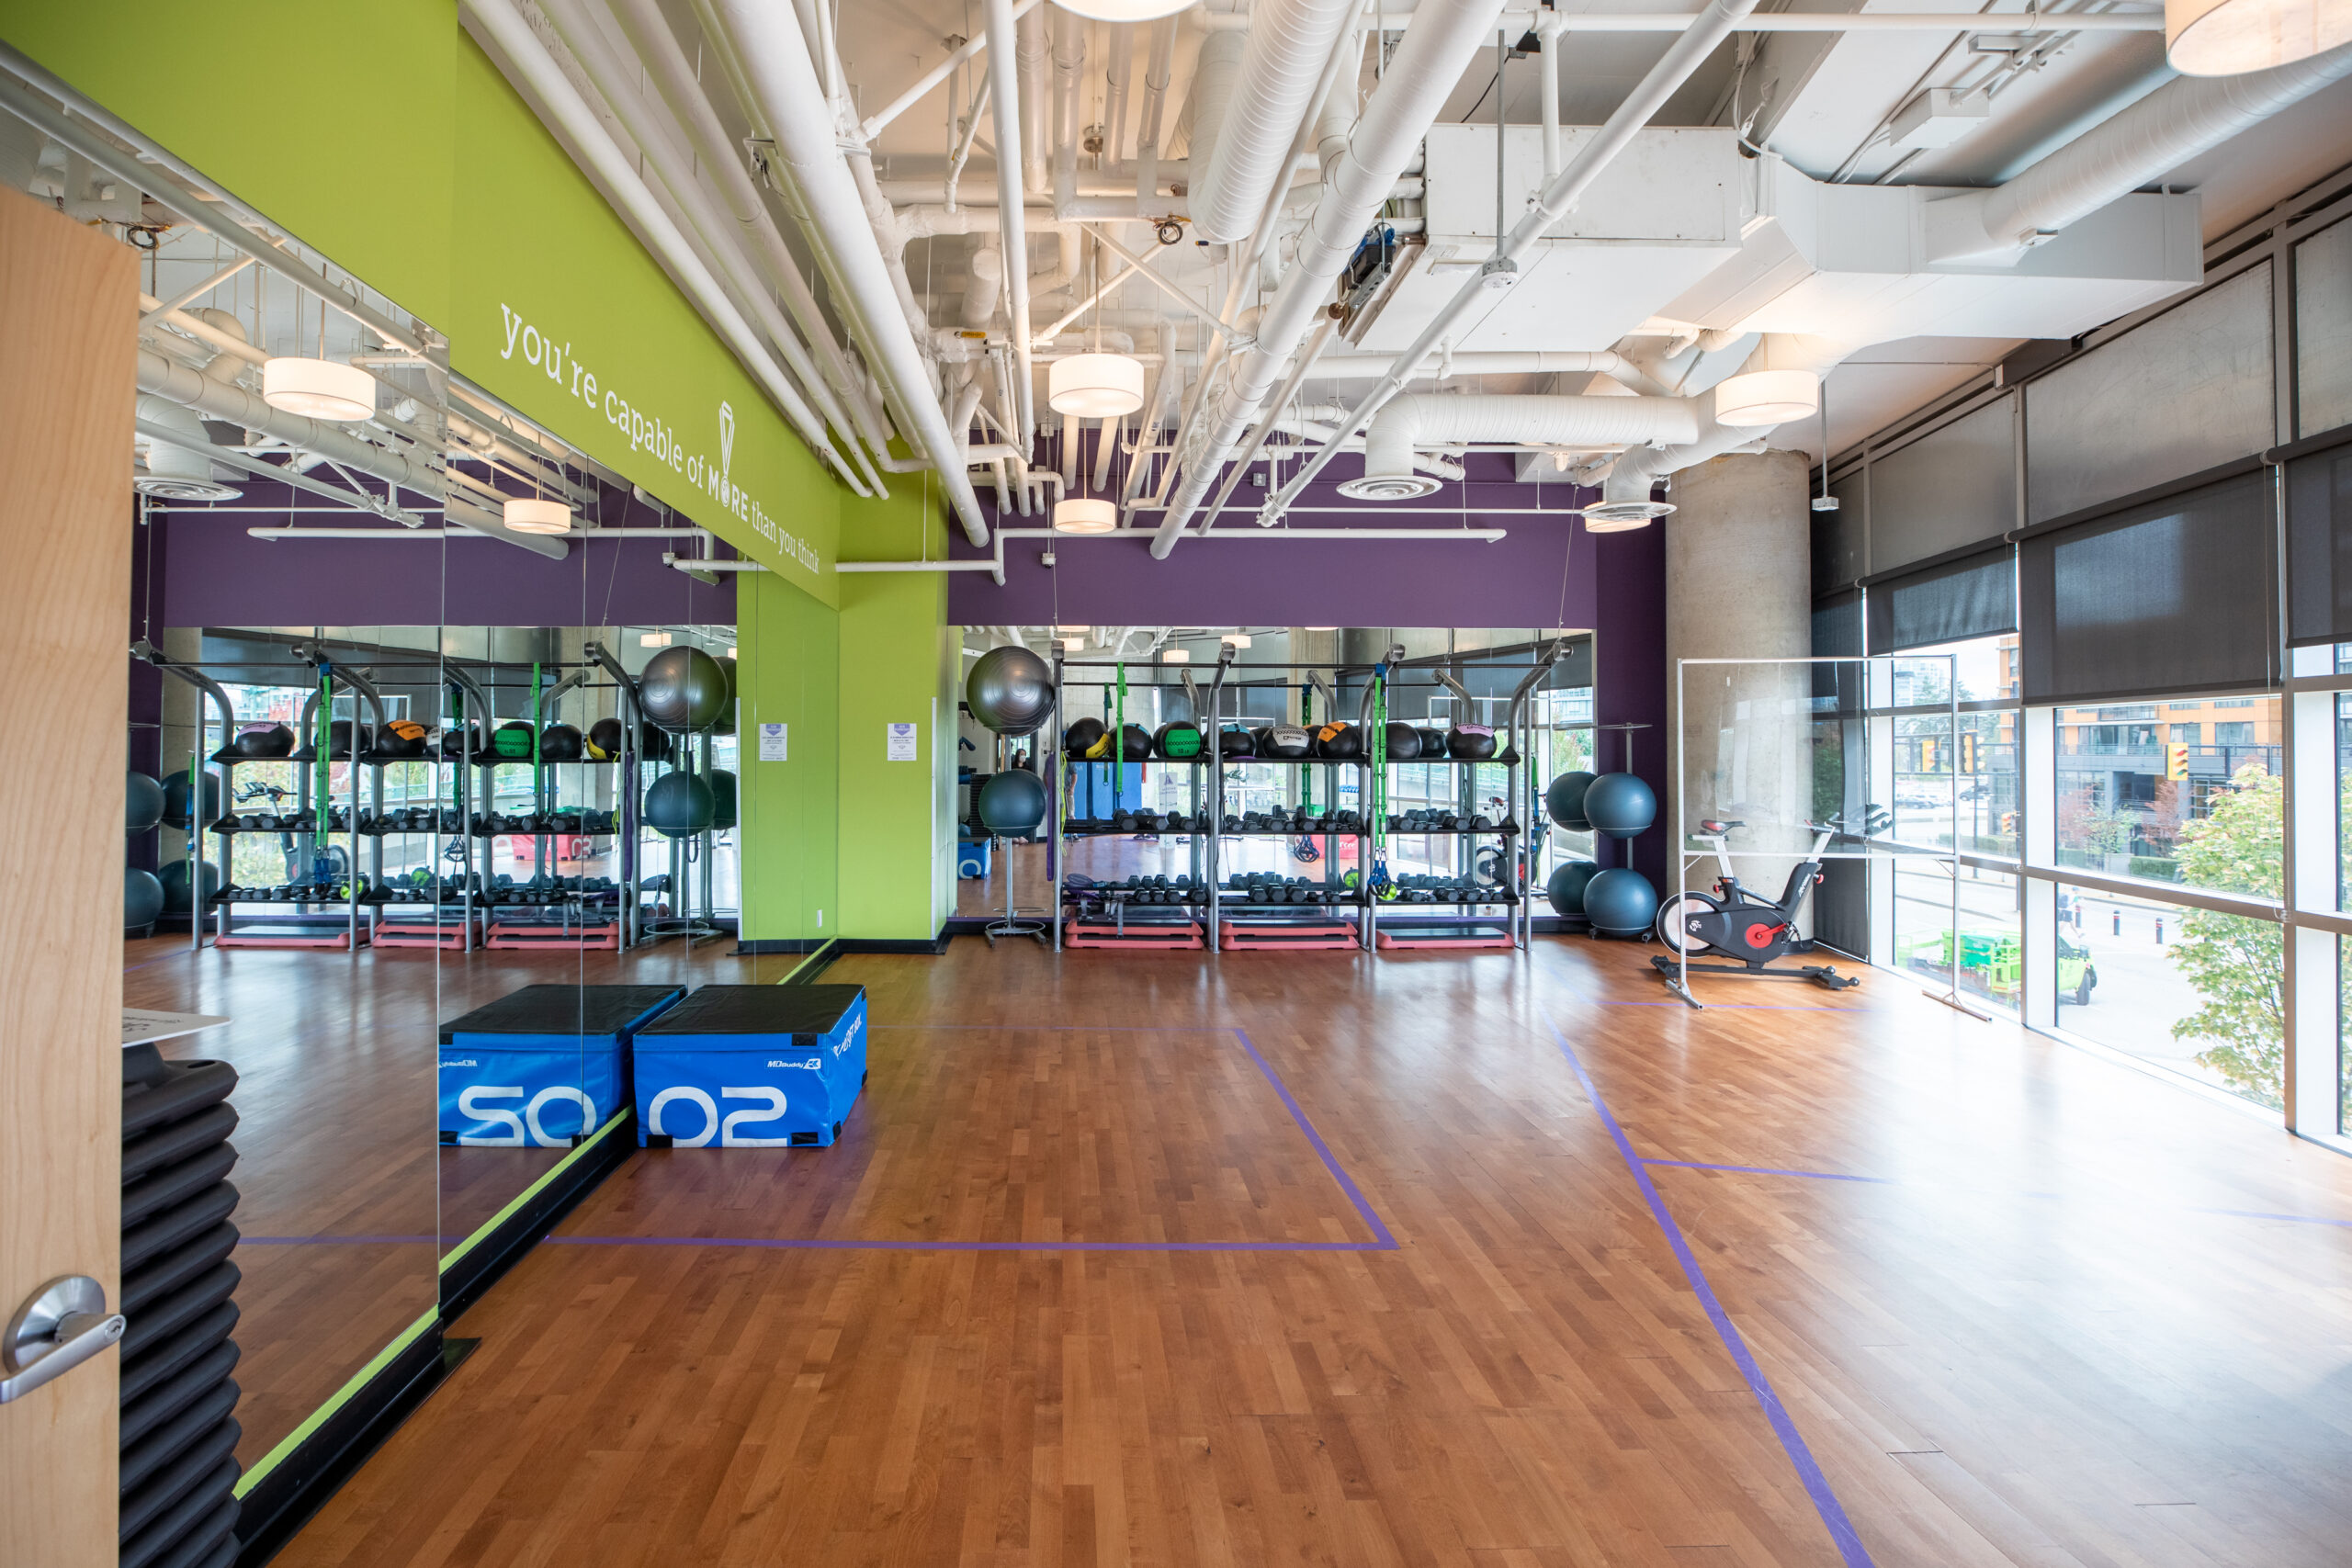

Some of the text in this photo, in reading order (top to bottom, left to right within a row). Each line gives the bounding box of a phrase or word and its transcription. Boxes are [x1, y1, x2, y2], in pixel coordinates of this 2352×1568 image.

[501, 302, 820, 575] you're capable of MORE than you think
[648, 1086, 787, 1147] 02
